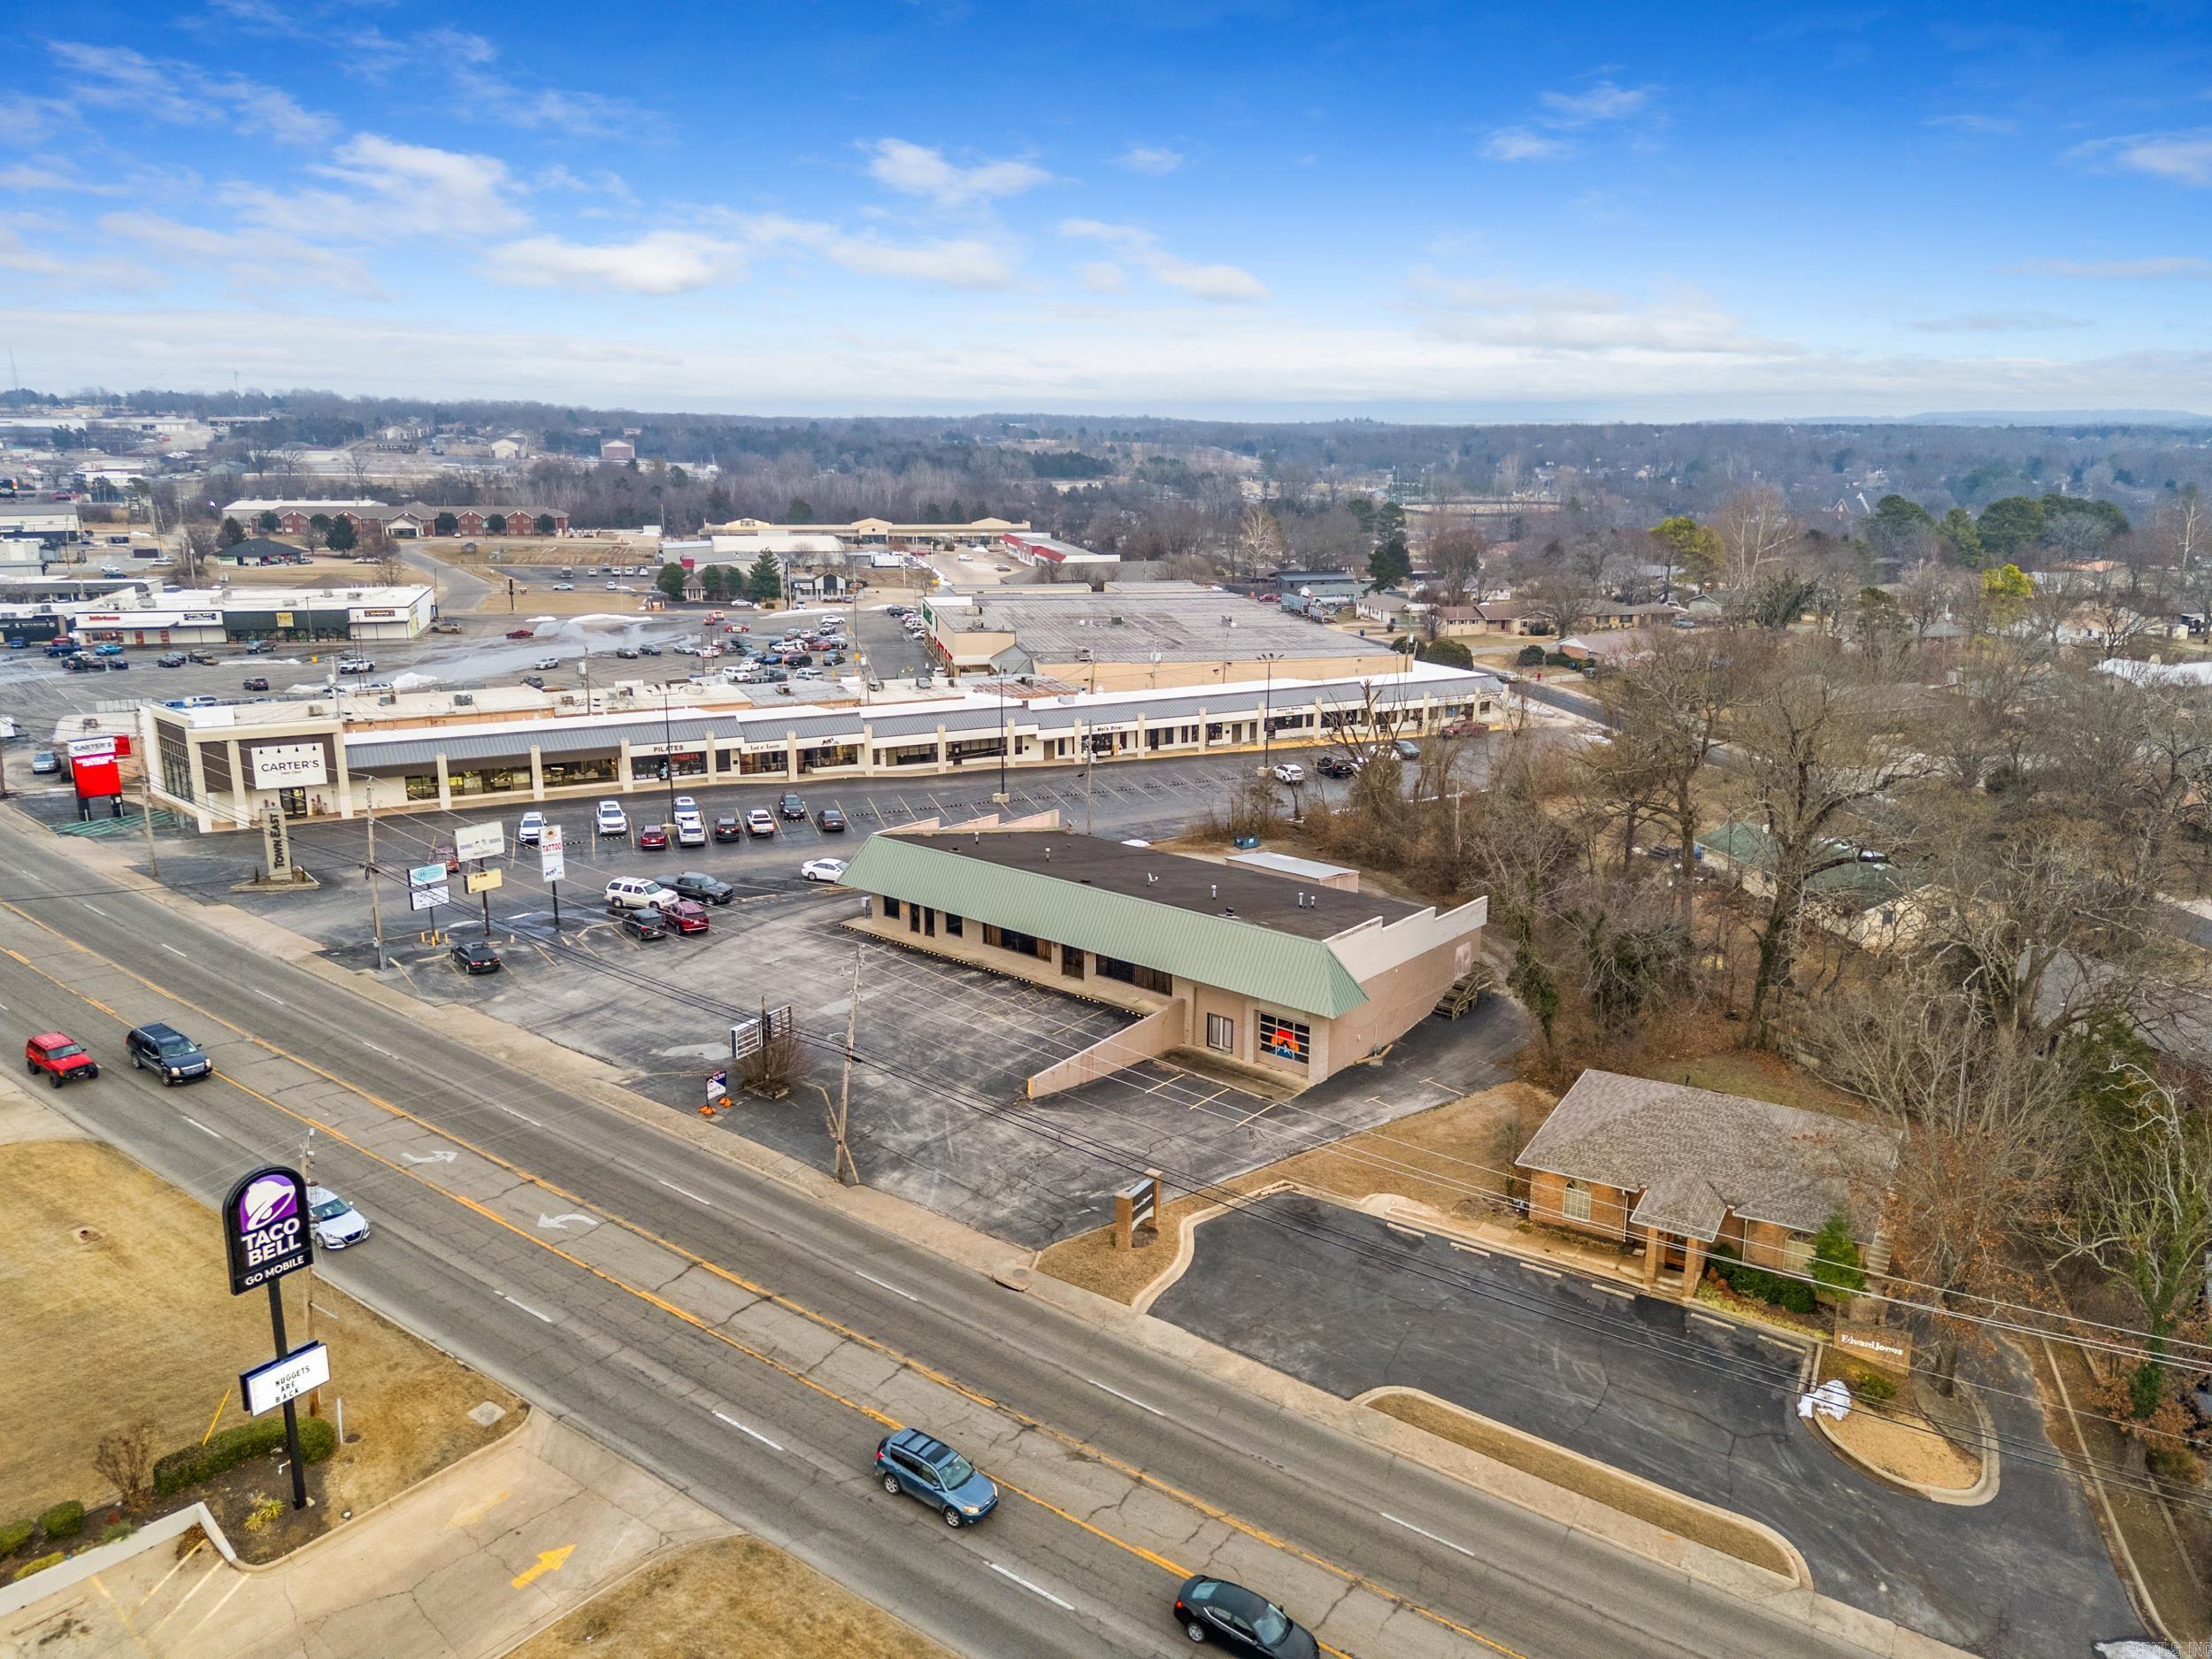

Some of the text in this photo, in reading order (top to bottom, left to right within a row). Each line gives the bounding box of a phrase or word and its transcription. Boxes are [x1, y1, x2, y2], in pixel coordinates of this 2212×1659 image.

[73, 741, 112, 750] CARTER'S
[261, 759, 319, 772] CARTER'S
[270, 813, 285, 869] TOWN EAST
[541, 842, 562, 851] TATTOO
[241, 1217, 301, 1250] TACO
[249, 1235, 302, 1267] BELL
[245, 1255, 304, 1286] GO MOBILE
[275, 1364, 311, 1386] NUGGETS
[275, 1387, 299, 1403] BACK
[281, 1380, 295, 1393] ARE
